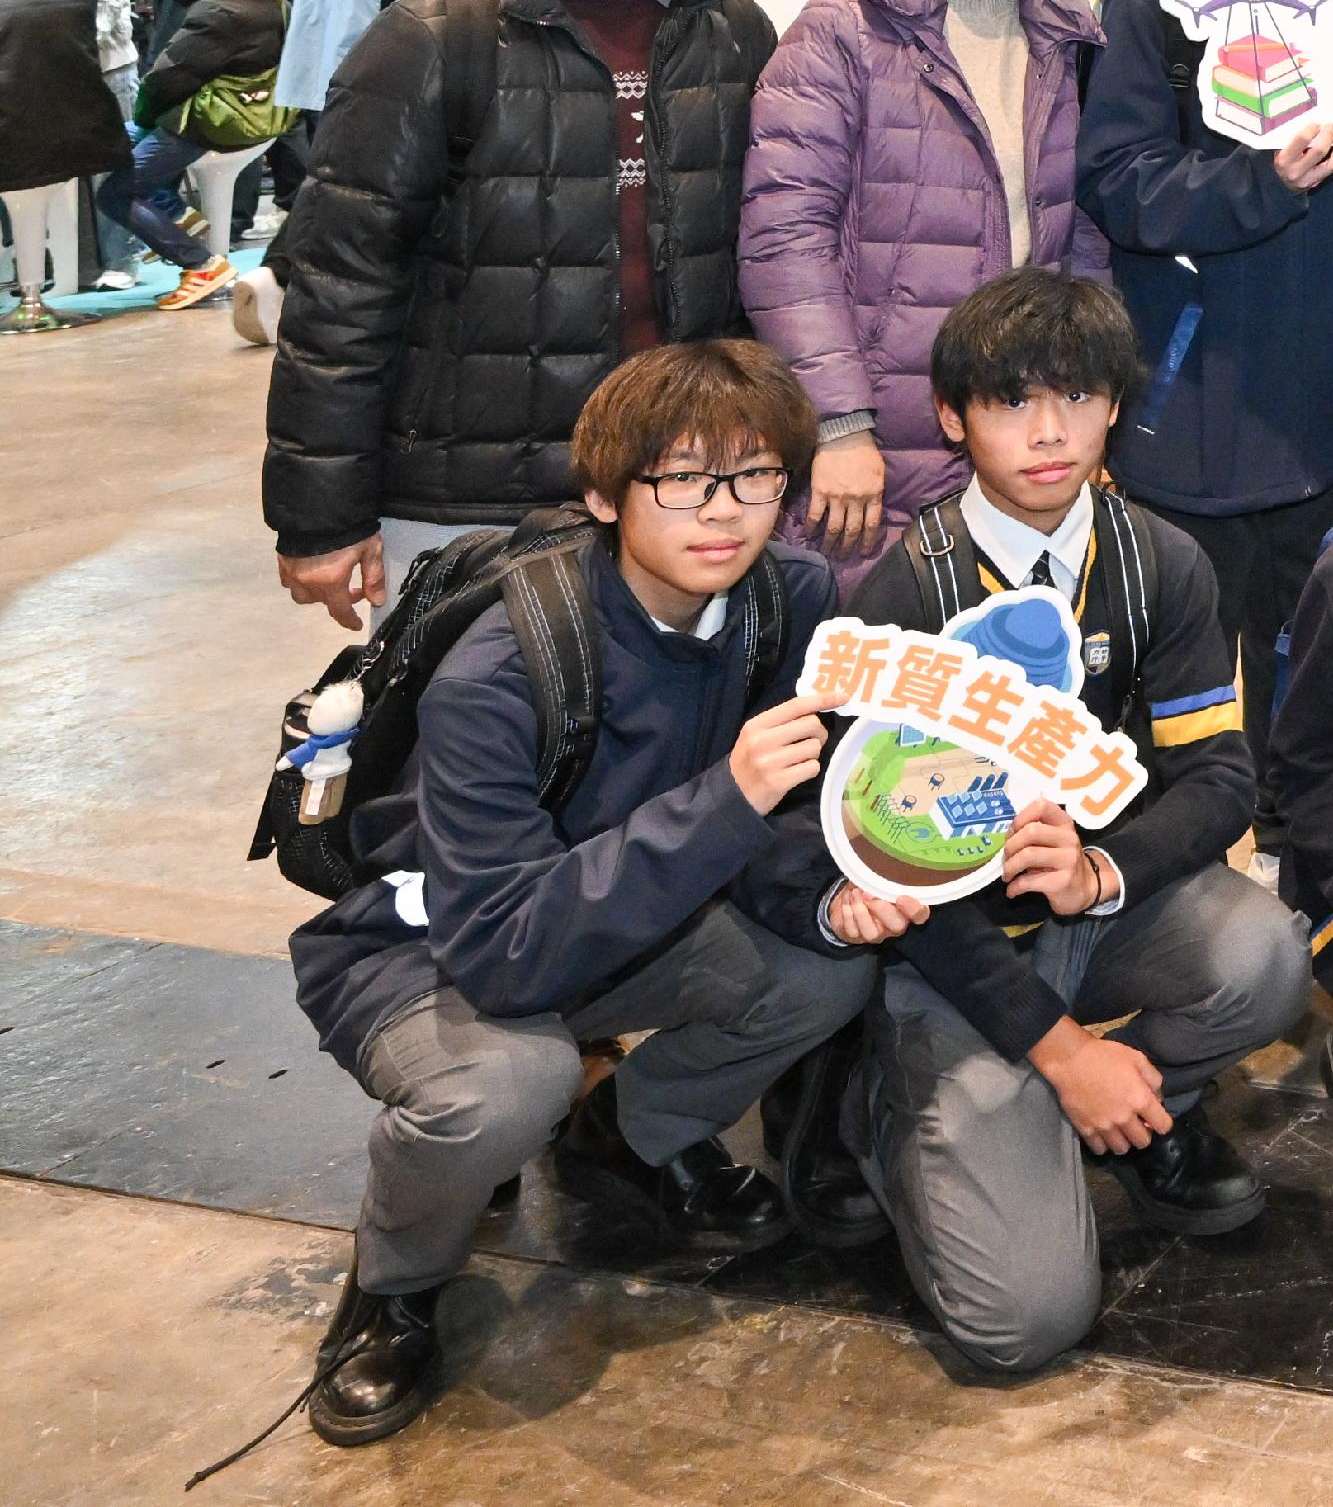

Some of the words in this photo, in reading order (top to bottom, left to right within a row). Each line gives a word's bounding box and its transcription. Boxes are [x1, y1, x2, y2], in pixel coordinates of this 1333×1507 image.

[812, 630, 1136, 816] 新質生產力
